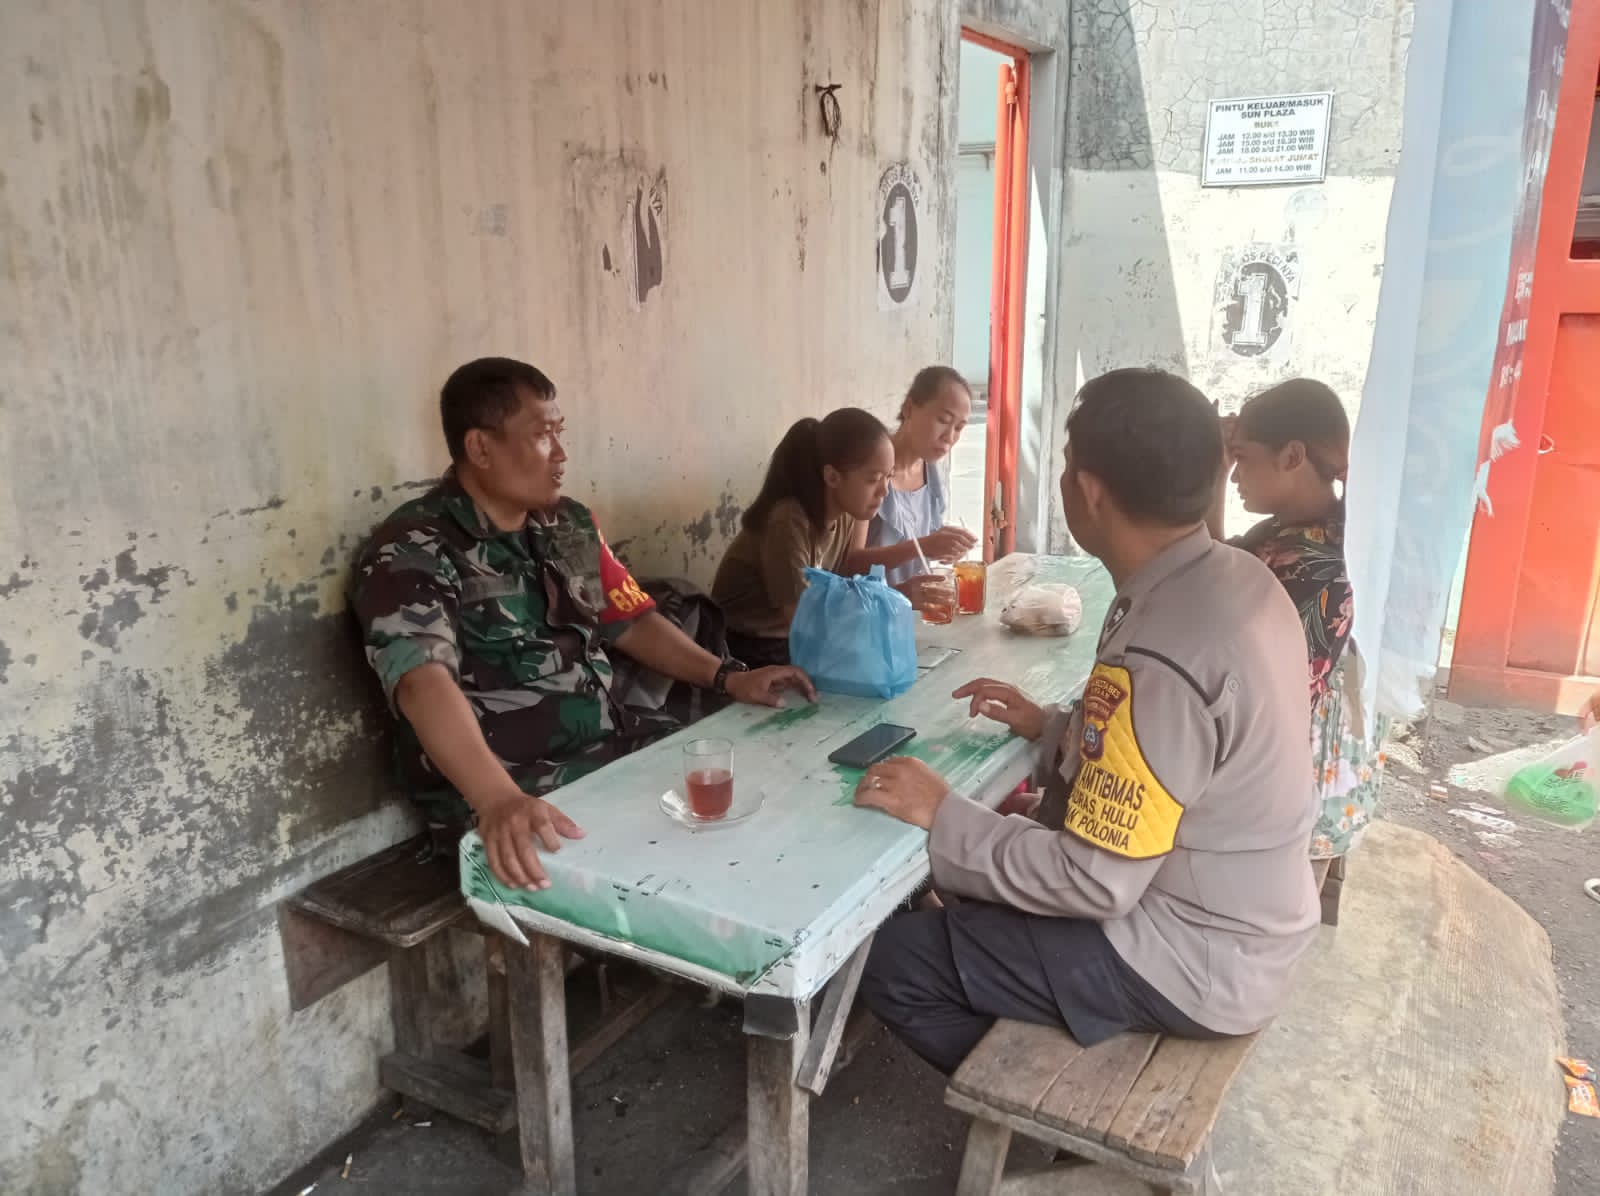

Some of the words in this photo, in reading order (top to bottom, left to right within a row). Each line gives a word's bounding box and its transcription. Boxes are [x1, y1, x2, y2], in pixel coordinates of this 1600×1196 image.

[1215, 104, 1245, 112] PINTU
[1247, 99, 1324, 110] KELUAR/MASUK
[1241, 111, 1260, 119] SUN
[1264, 109, 1296, 118] PLAZA
[1218, 133, 1235, 141] JAM
[1298, 136, 1315, 144] WIB
[1298, 143, 1314, 151] WIB
[1287, 153, 1320, 162] JUMAT
[1215, 167, 1232, 175] JAM
[1239, 166, 1259, 174] 11.00
[1100, 803, 1139, 831] HULU
[1077, 815, 1130, 851] POLONIA
